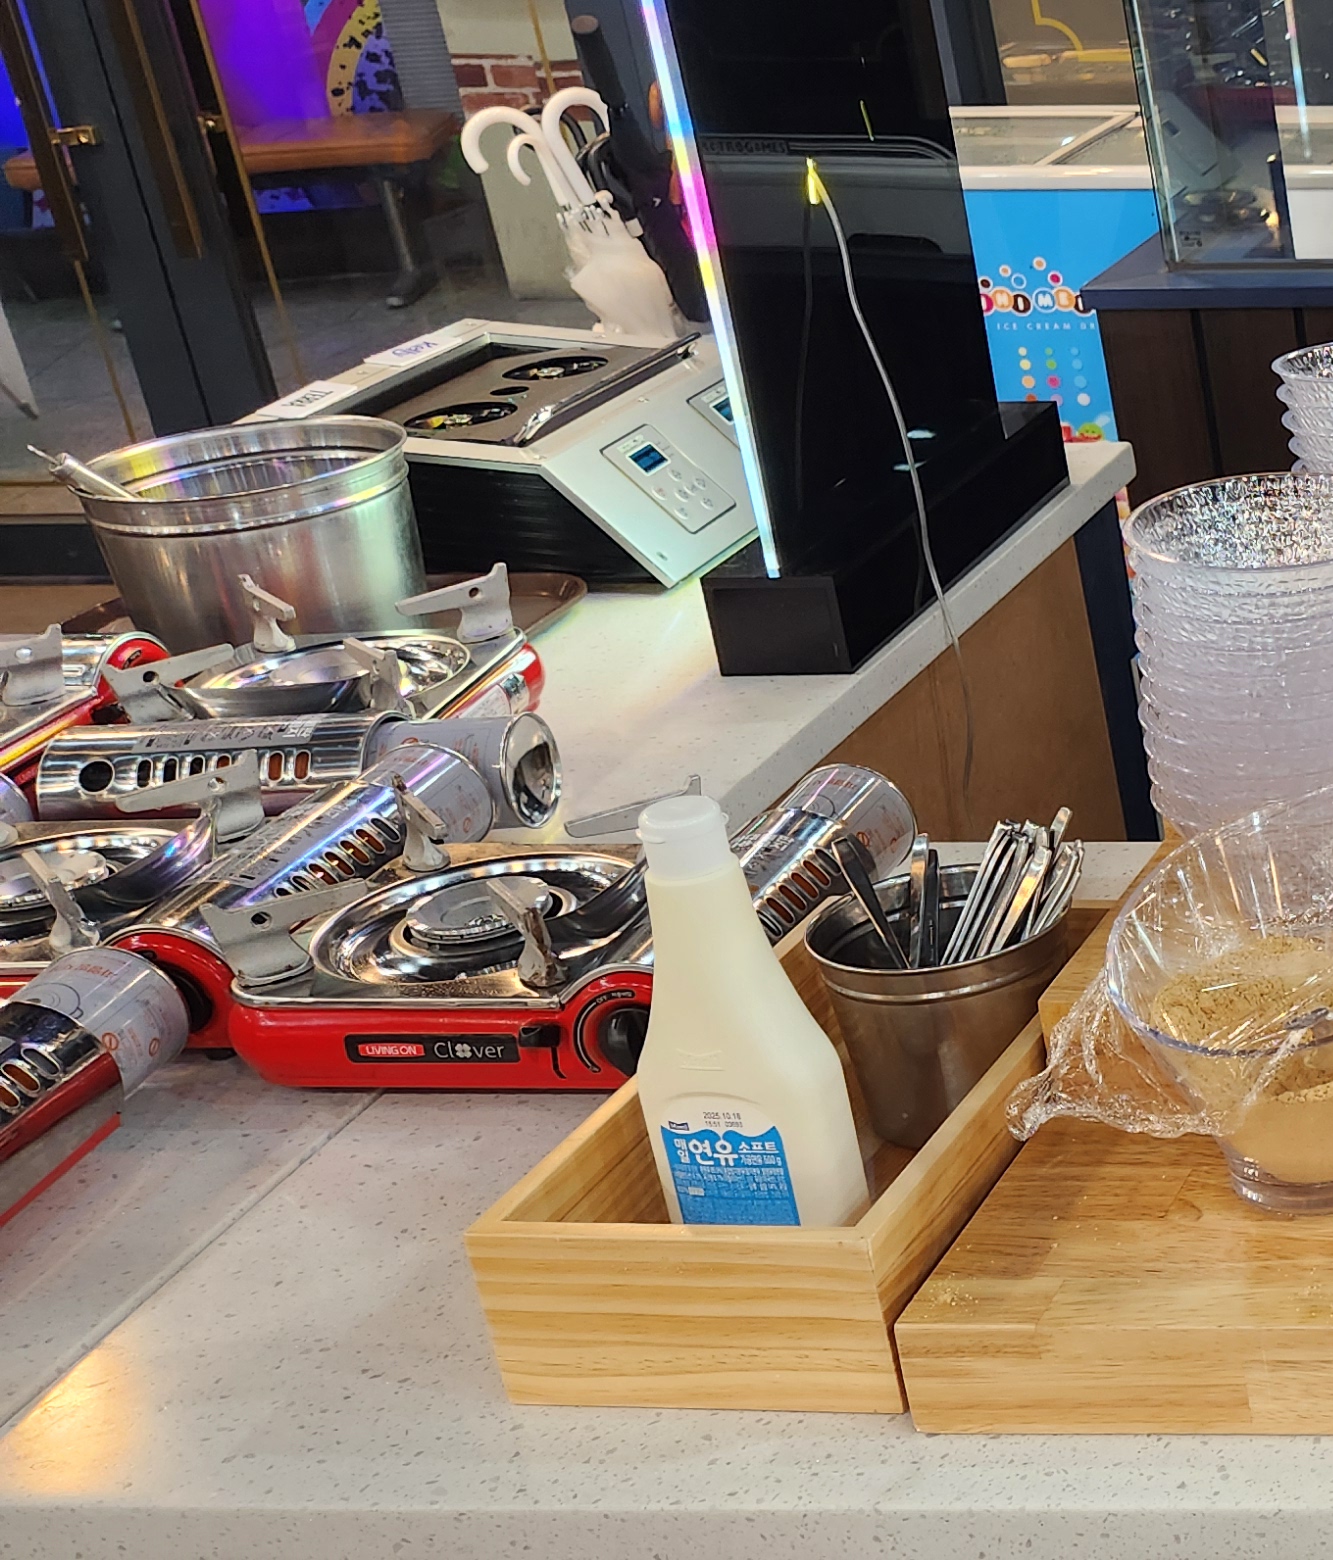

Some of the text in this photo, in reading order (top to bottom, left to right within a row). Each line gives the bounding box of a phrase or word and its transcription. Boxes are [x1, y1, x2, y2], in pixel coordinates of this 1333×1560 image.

[996, 322, 1019, 331] ICE
[689, 1138, 739, 1167] 연유
[738, 1141, 780, 1154] 소프트
